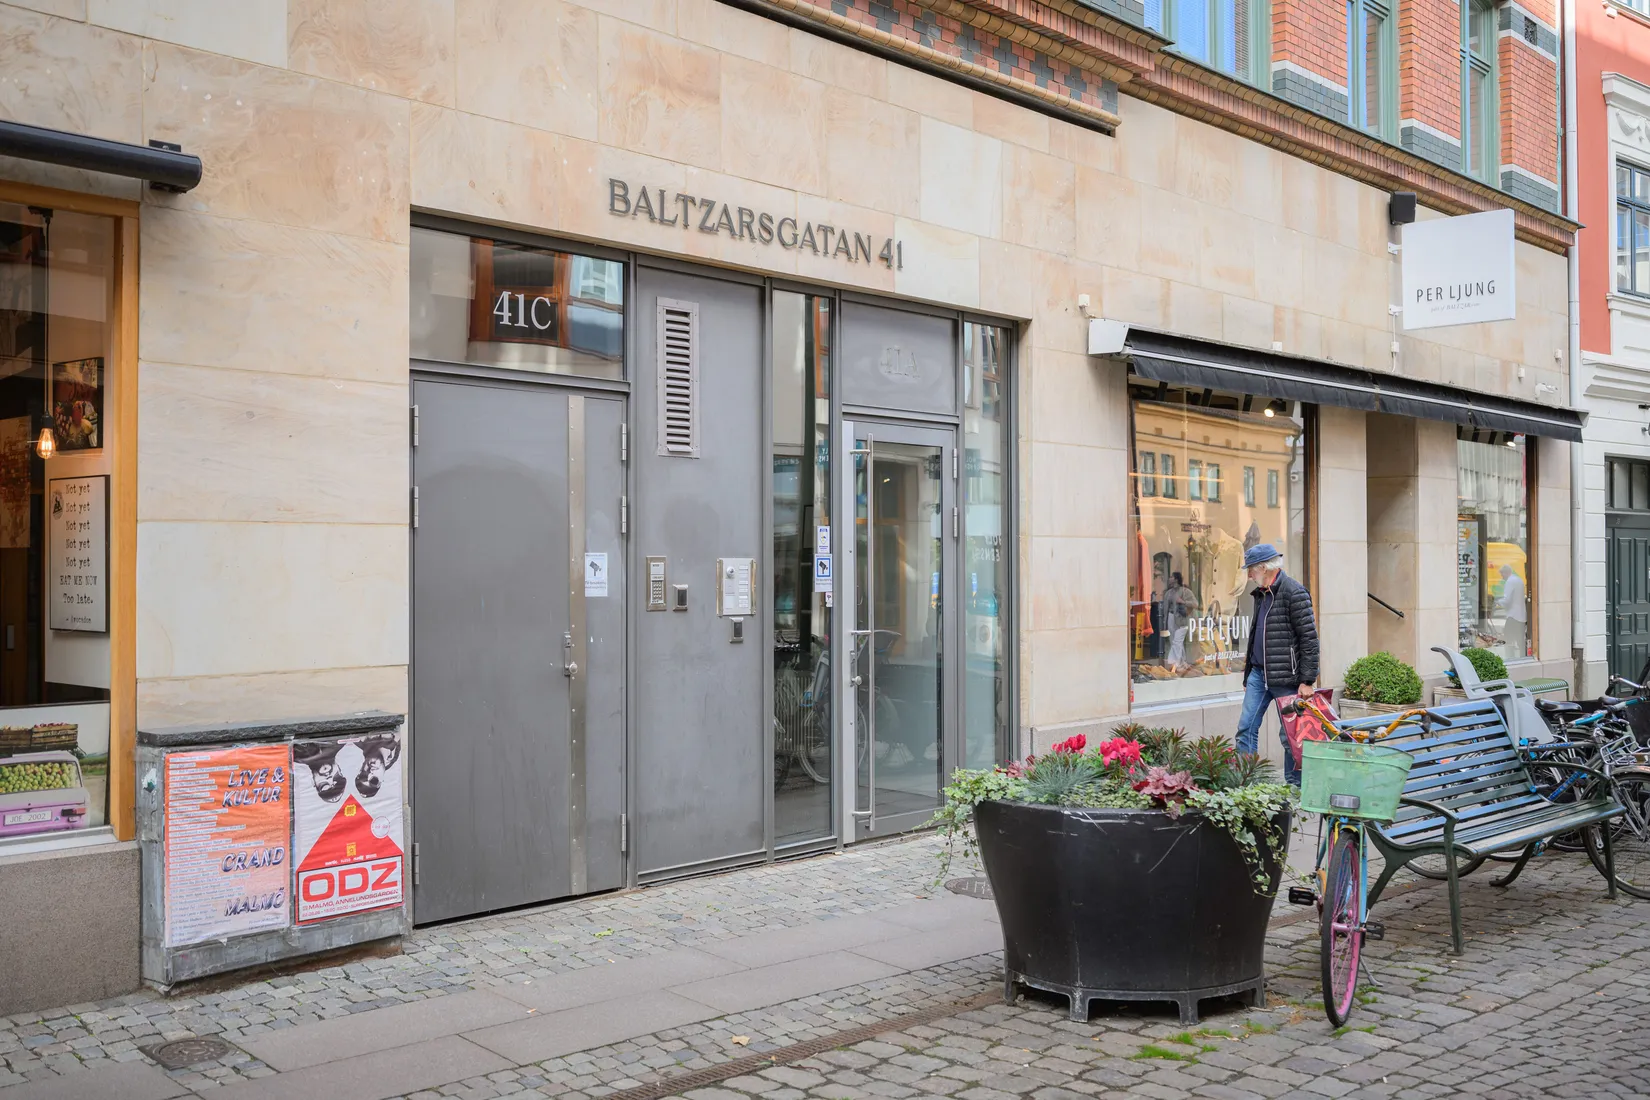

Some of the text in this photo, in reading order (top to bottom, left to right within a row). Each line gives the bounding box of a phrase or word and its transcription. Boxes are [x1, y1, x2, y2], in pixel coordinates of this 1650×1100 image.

[608, 177, 904, 271] BALTZARSGATAN 41
[1416, 279, 1496, 303] PER LJUNG
[493, 290, 552, 331] 41C
[65, 483, 90, 496] Not yet
[65, 501, 90, 514] Not yet
[65, 520, 90, 532] Not yet
[65, 538, 90, 551] Not yet
[65, 556, 90, 569] Not yet
[60, 575, 97, 586] EAT ME NOW
[63, 592, 74, 604] Too
[1188, 615, 1252, 645] PER LJUN
[228, 766, 285, 788] LIVE &
[222, 785, 281, 808] KULTUR
[28, 813, 46, 821] 2002
[302, 861, 398, 903] ODZ
[224, 887, 285, 917] MALMÖ
